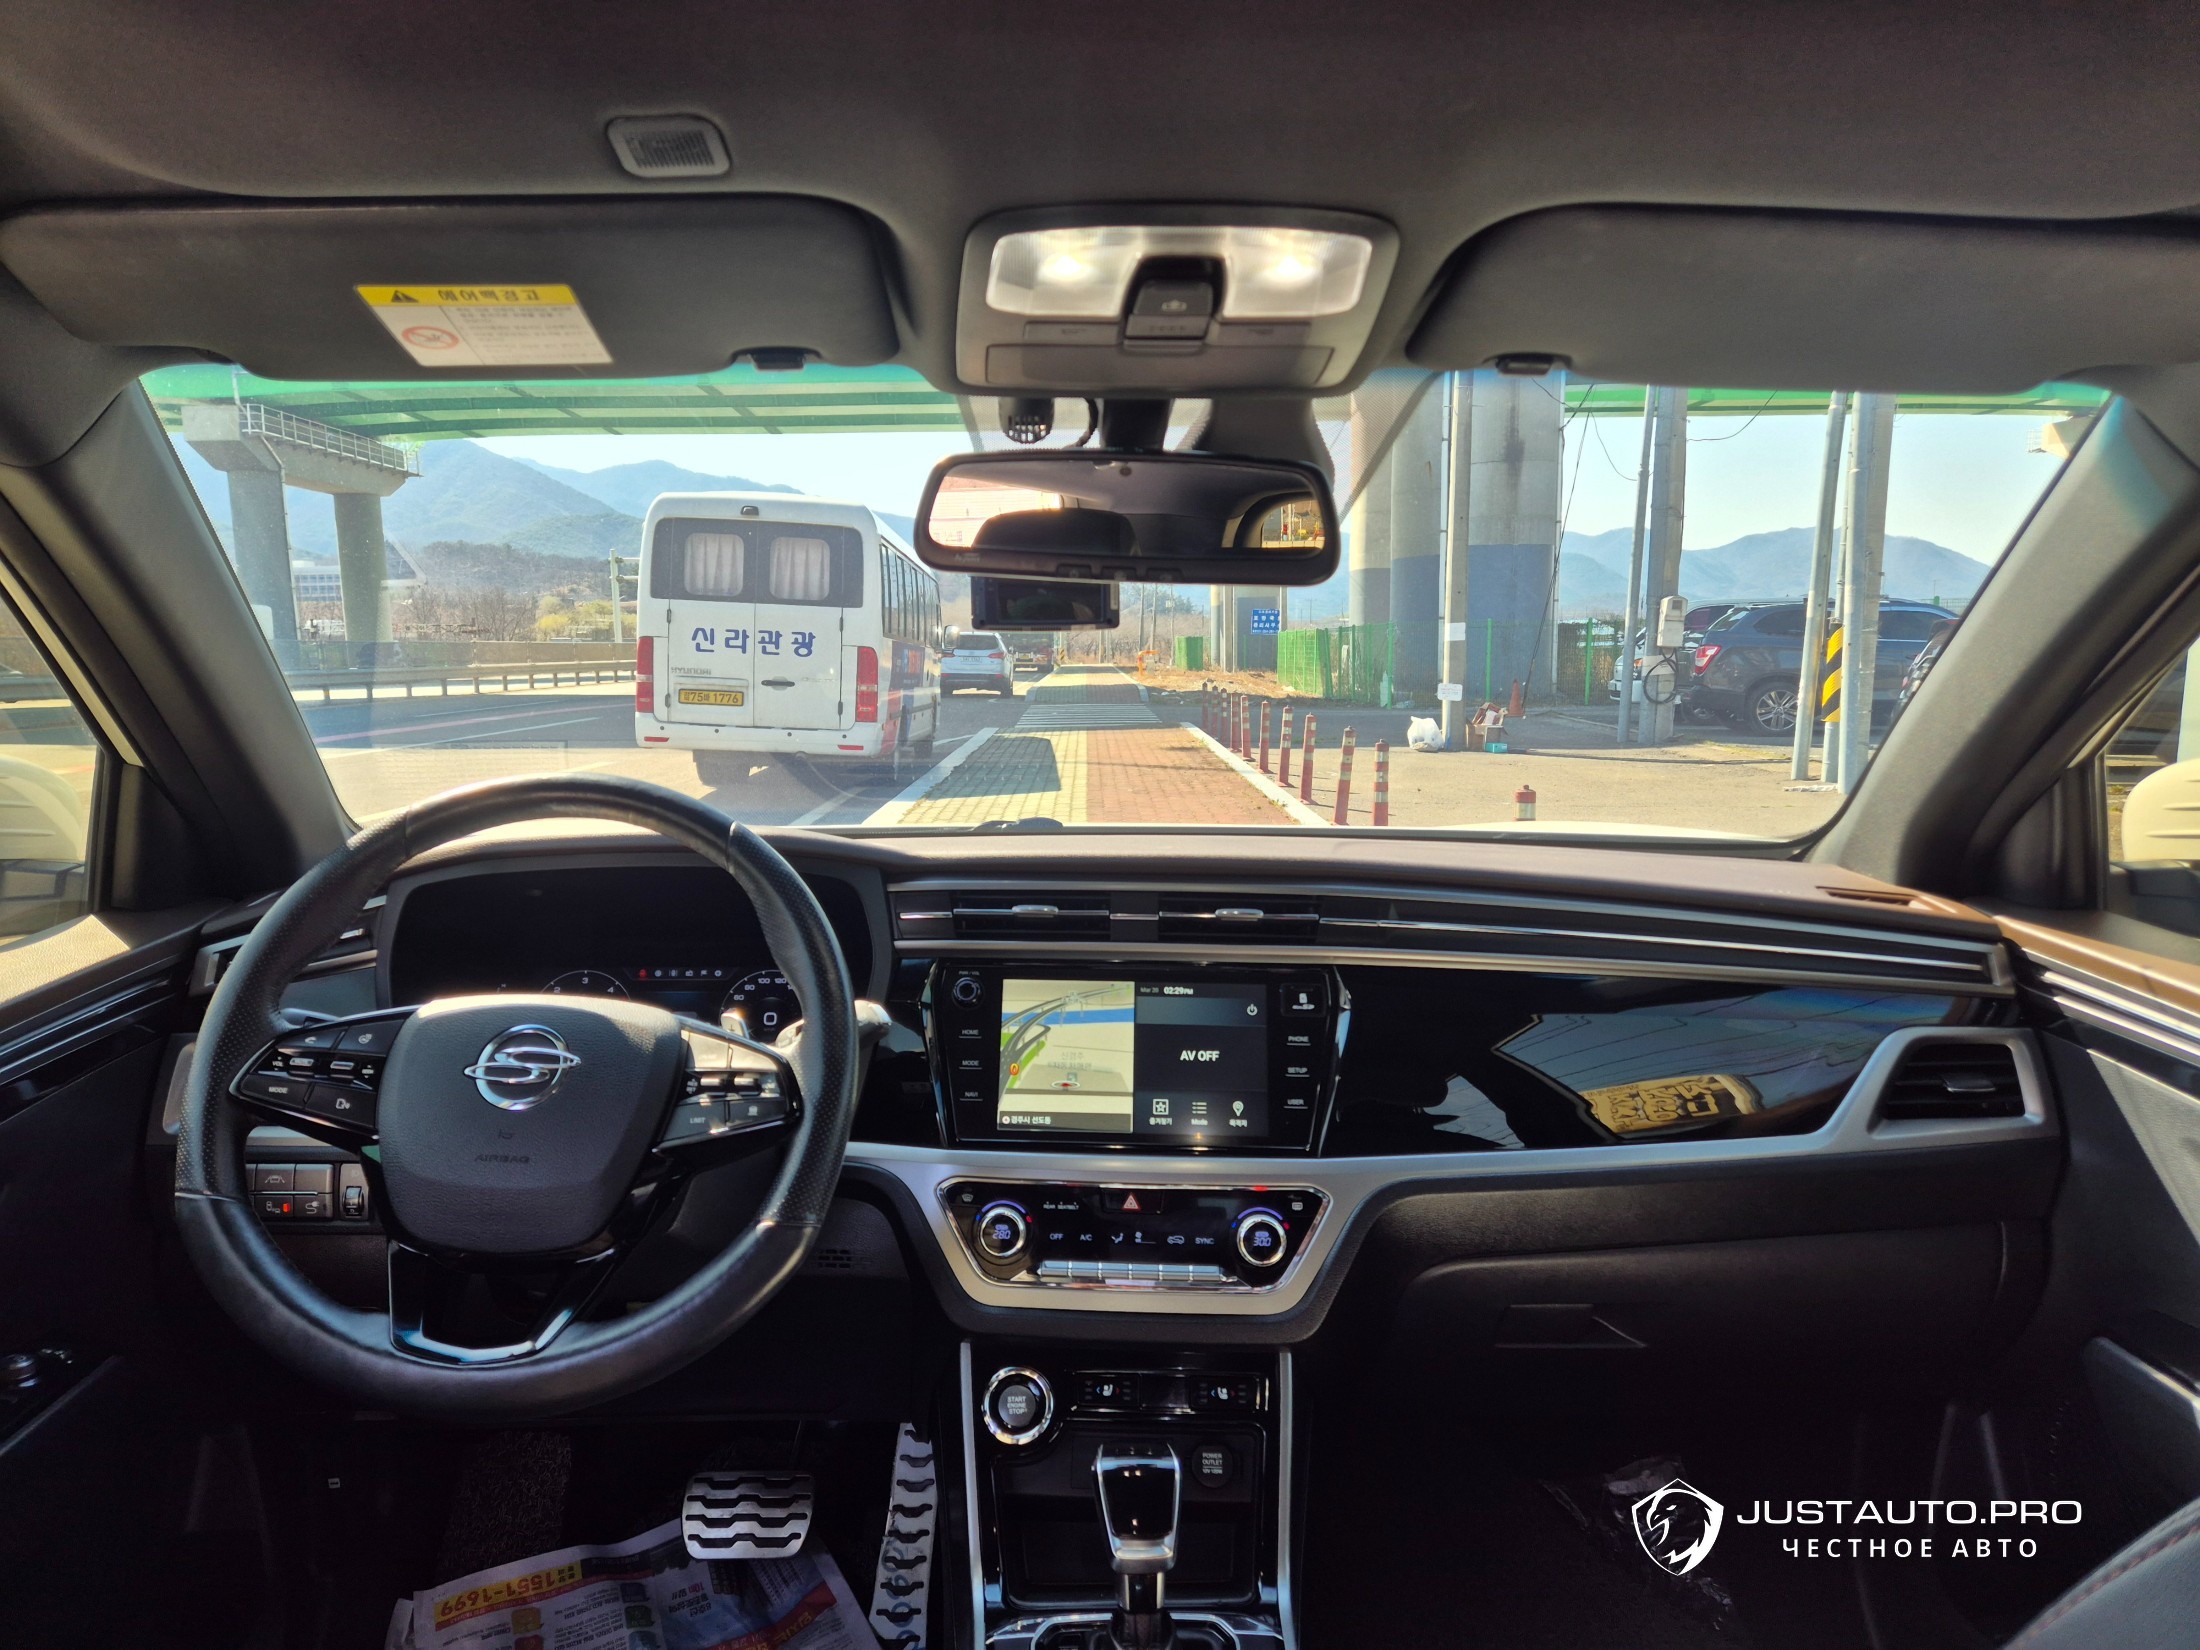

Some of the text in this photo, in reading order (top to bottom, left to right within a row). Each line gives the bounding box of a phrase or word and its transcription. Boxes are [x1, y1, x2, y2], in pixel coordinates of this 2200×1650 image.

[691, 627, 816, 658] 신라관광
[713, 692, 739, 704] 1776
[1180, 1050, 1220, 1062] AV OFF
[440, 1572, 555, 1617] 1551-1699
